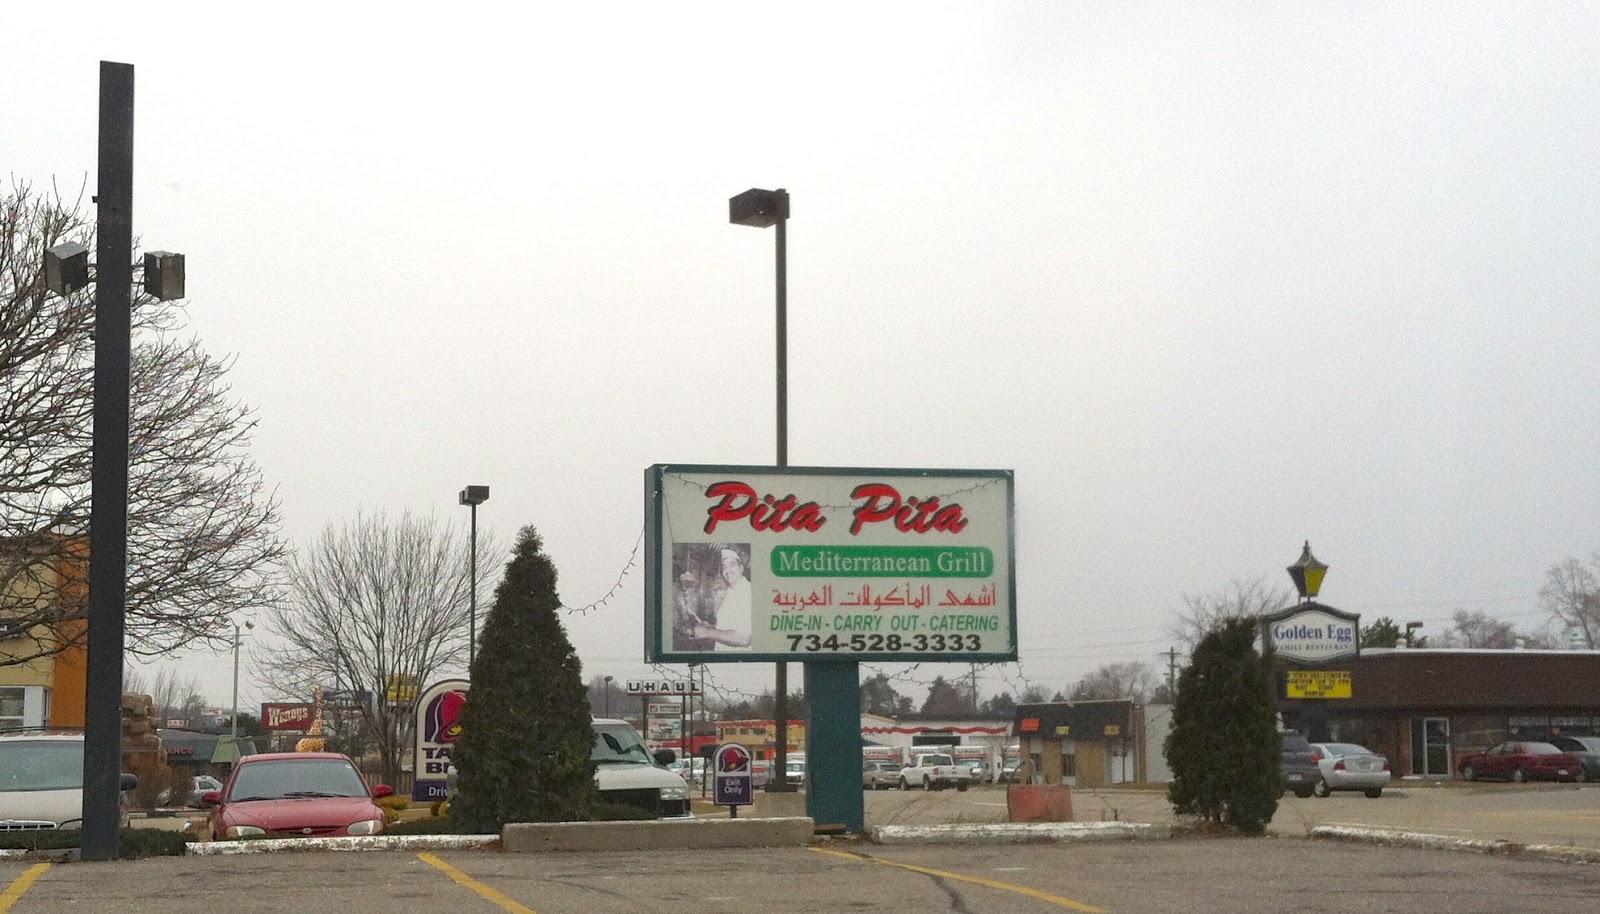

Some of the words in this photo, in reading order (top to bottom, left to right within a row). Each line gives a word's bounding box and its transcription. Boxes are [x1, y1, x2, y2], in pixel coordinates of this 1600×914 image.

[703, 481, 826, 535] Pita
[850, 483, 969, 536] Pita
[779, 551, 931, 571] Mediterranean
[937, 552, 986, 572] Grill
[770, 615, 821, 631] DINE-IN
[833, 615, 882, 631] CARRY
[890, 615, 919, 631] OUT
[929, 615, 999, 631] CATERING
[1274, 624, 1323, 640] Golden
[1327, 624, 1352, 642] Egg
[786, 634, 982, 652] 734-528-3333
[723, 786, 743, 795] Only
[726, 778, 741, 786] Exit
